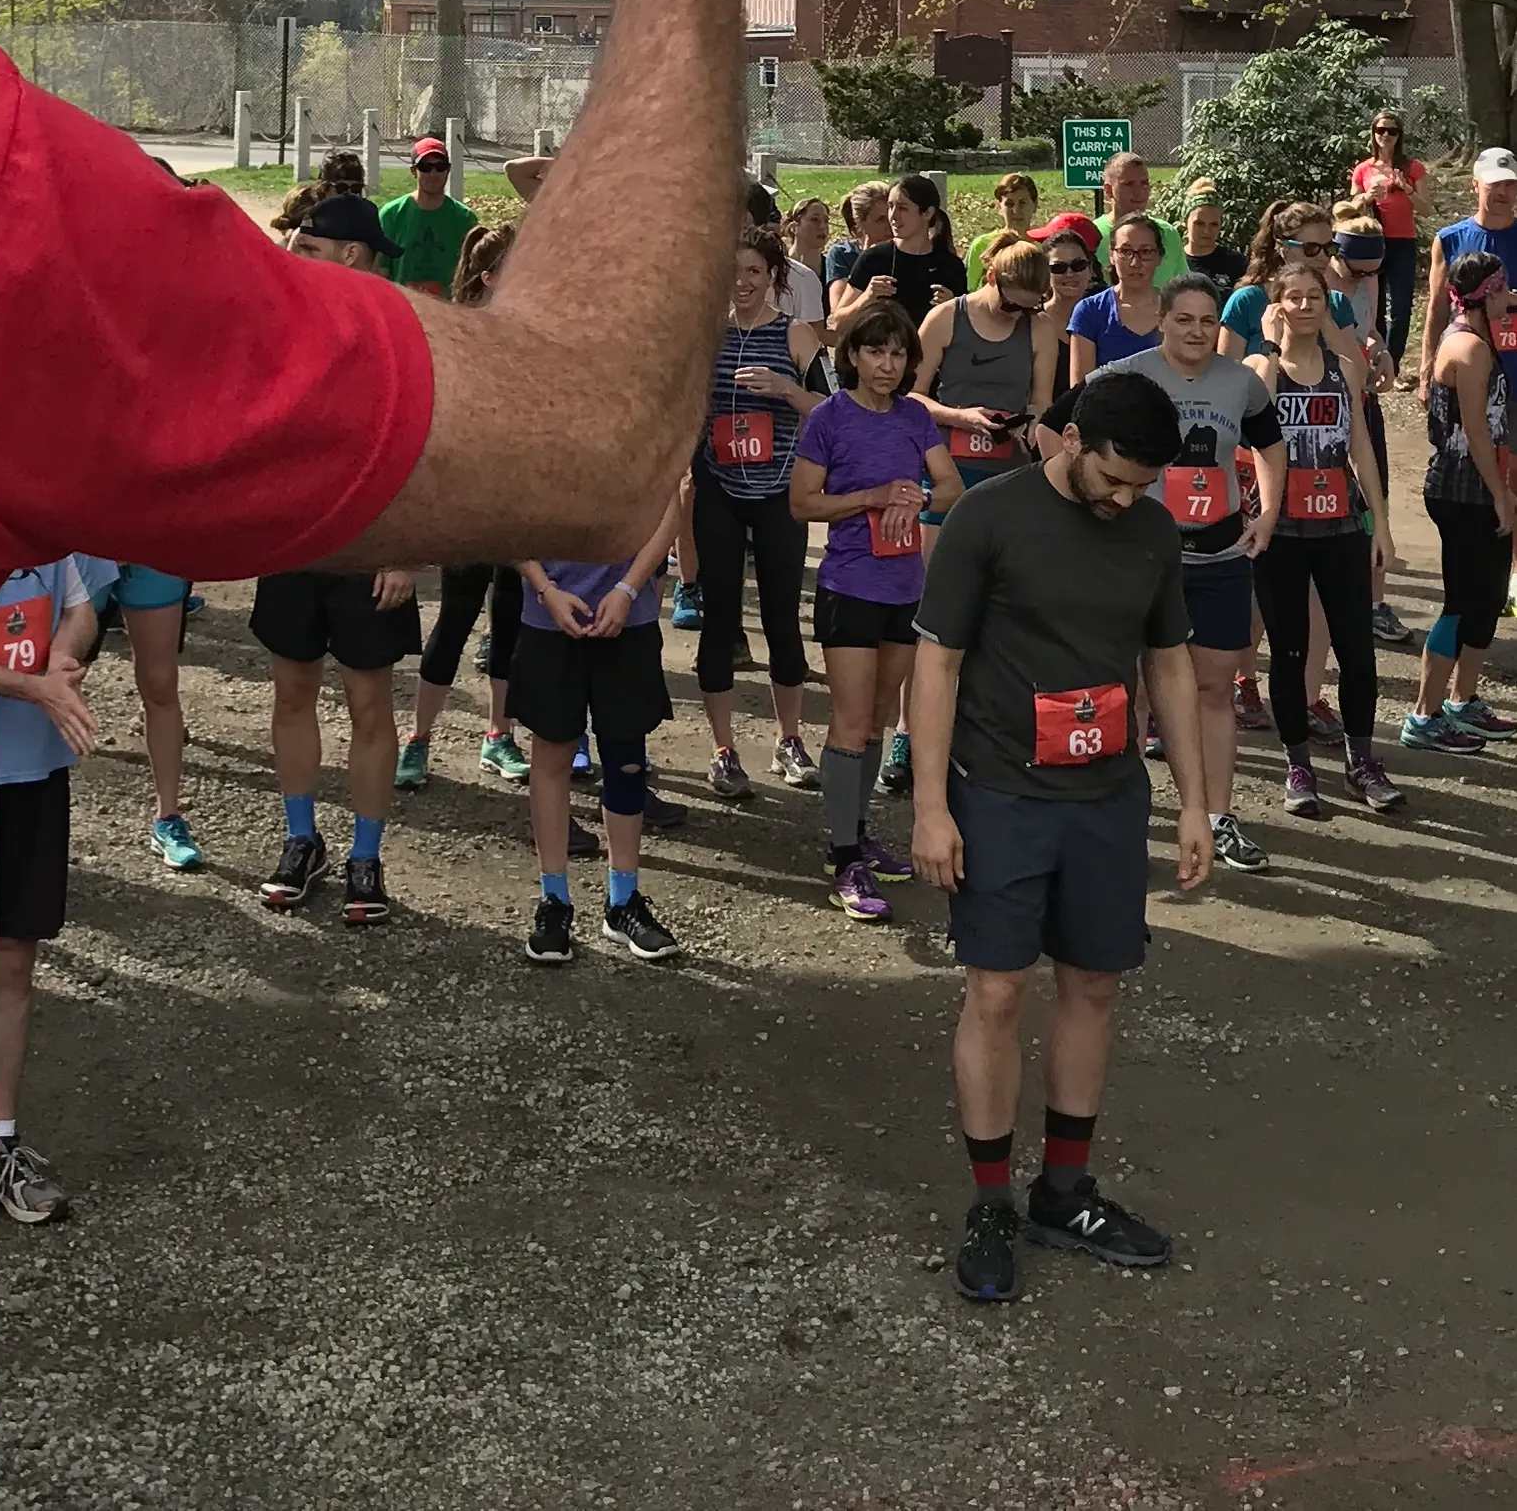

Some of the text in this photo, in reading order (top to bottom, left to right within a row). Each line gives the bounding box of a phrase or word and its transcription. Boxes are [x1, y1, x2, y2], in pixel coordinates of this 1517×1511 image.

[1072, 126, 1124, 138] THIS IS A
[1072, 141, 1123, 153] CARRY-IN
[1067, 155, 1108, 167] CARRY-
[1085, 170, 1106, 182] PAR
[1499, 332, 1517, 347] 78
[1276, 396, 1338, 425] SIX03
[727, 437, 761, 458] 110
[969, 434, 993, 453] 86
[1189, 443, 1209, 453] 2015
[1187, 495, 1212, 516] 77
[1303, 494, 1337, 514] 103
[3, 639, 36, 670] 79
[1069, 727, 1103, 757] 63
